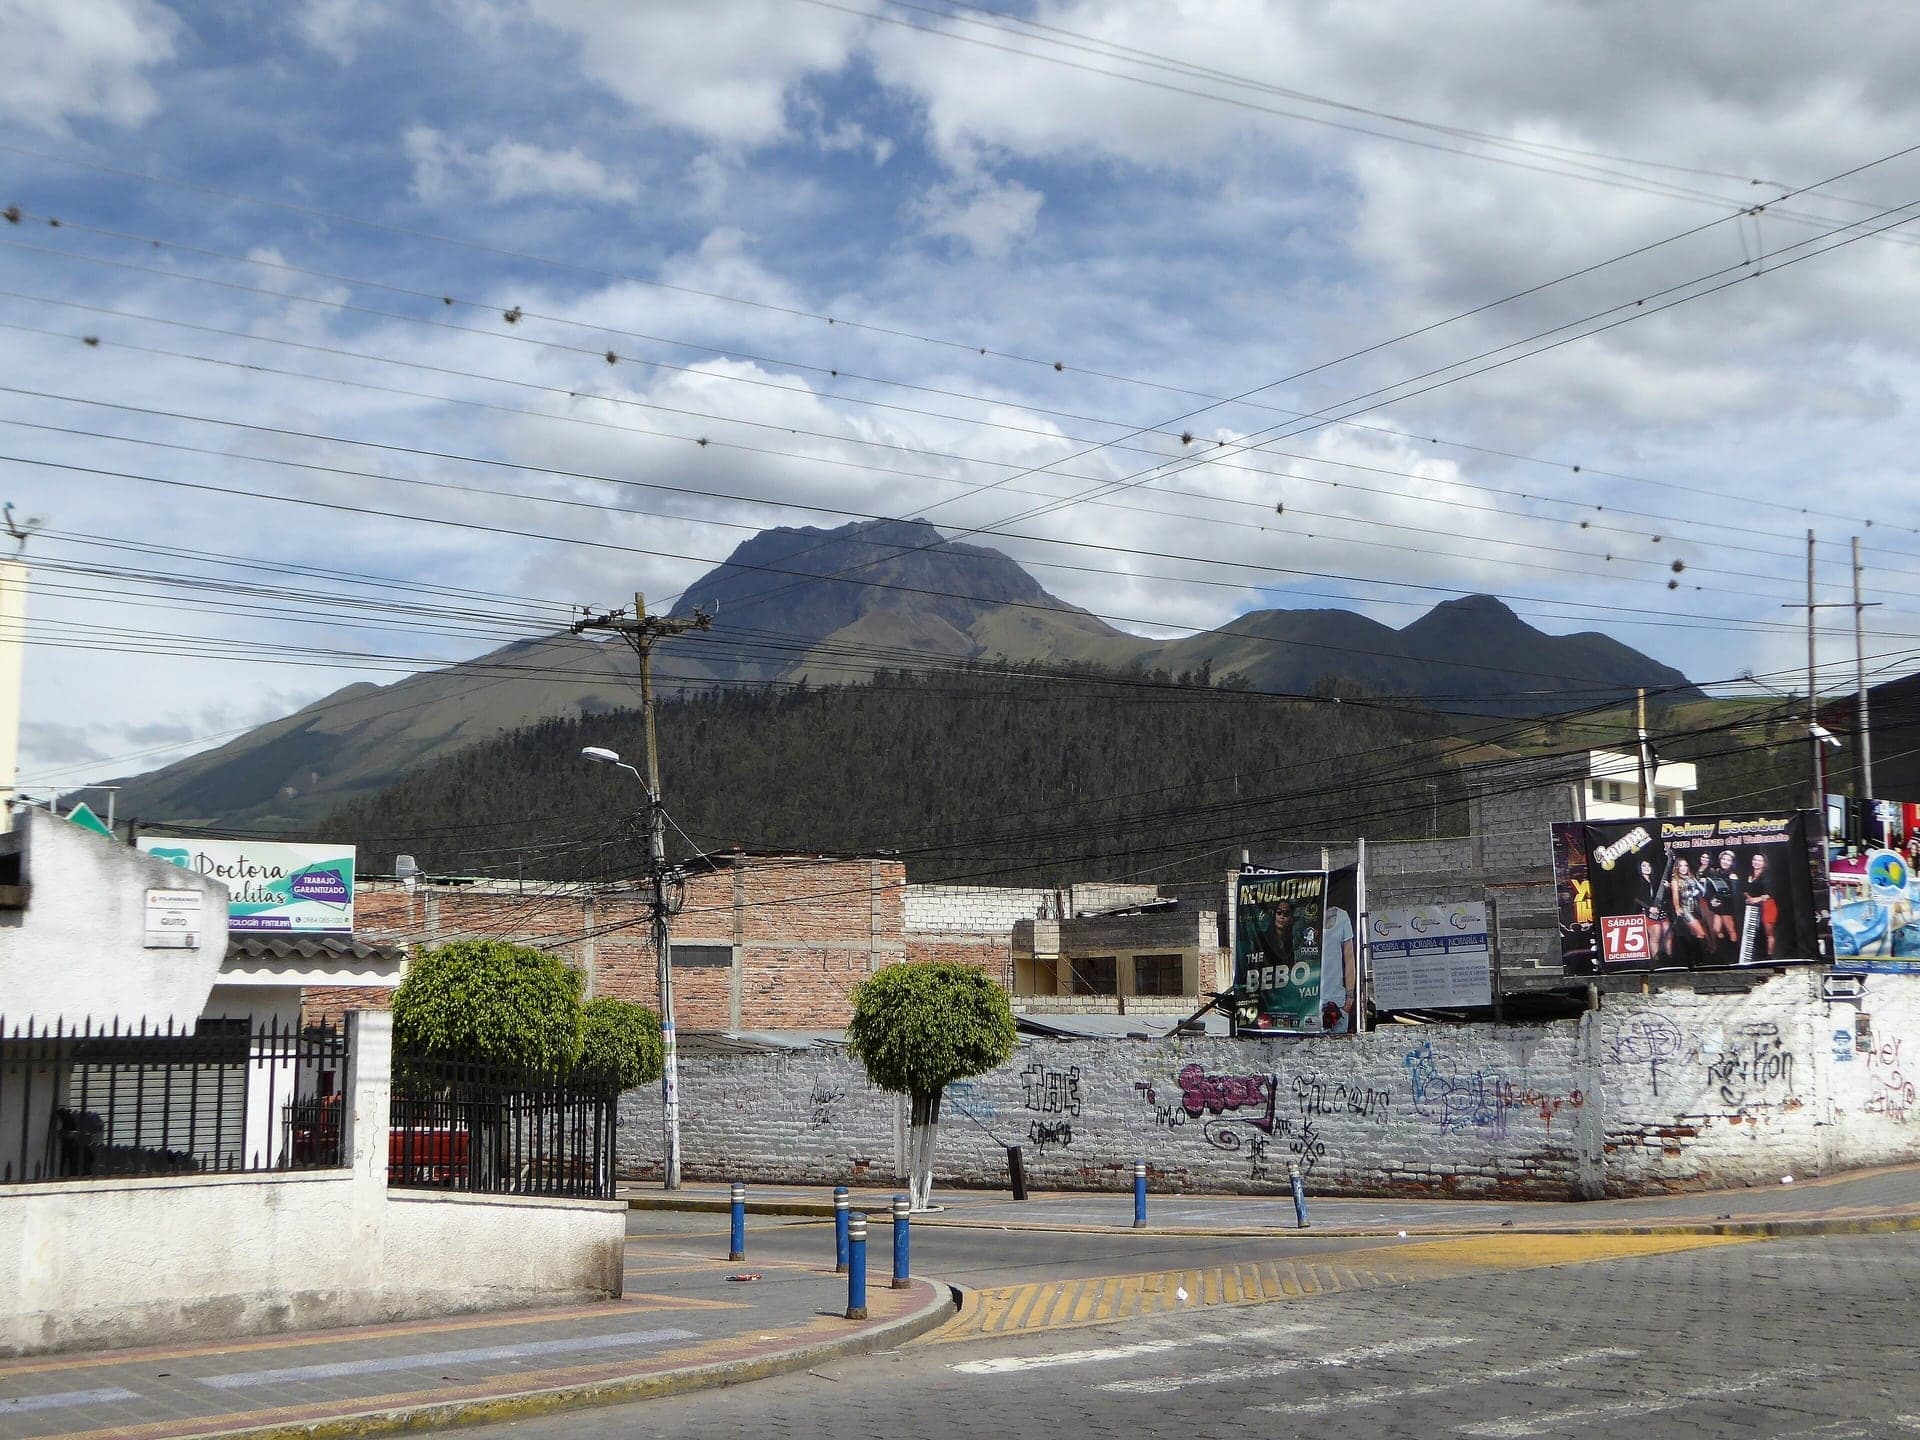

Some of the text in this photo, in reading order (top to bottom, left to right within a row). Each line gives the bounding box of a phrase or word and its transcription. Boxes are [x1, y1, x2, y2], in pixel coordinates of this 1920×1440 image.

[1718, 817, 1789, 834] Escobar
[1663, 841, 1672, 850] y
[1691, 837, 1724, 848] Musas
[1725, 836, 1742, 846] del
[194, 852, 288, 879] Doctora
[303, 876, 336, 885] TRABAJO
[293, 885, 345, 895] GARANTIZADO
[1240, 877, 1322, 905] REVOLUTION
[1607, 918, 1643, 927] SÁBADO
[1606, 927, 1645, 952] 15
[1246, 952, 1264, 964] THE
[1608, 952, 1647, 960] DICIEMBRE
[1246, 961, 1311, 993] BEBO
